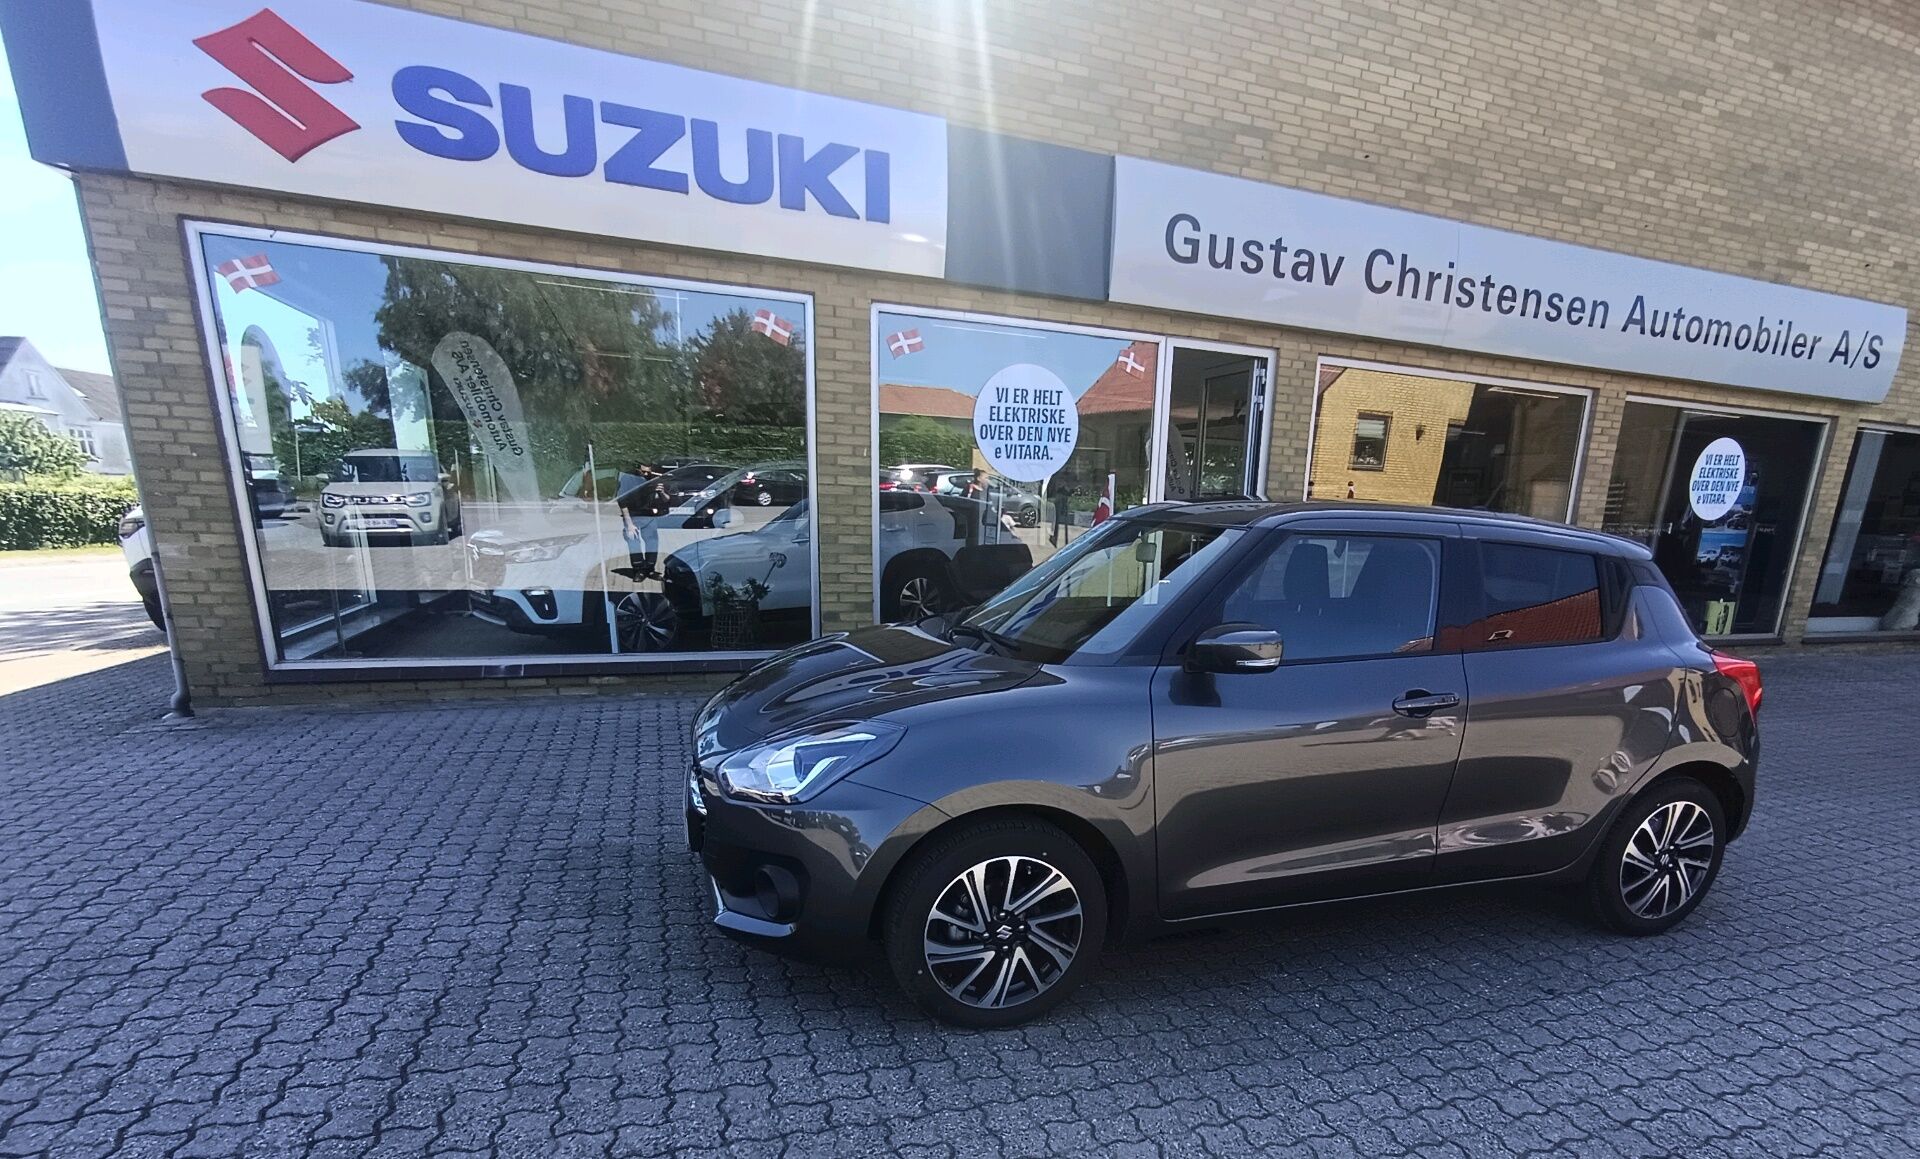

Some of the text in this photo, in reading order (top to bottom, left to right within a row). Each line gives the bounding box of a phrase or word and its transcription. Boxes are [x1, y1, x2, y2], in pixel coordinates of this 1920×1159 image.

[391, 64, 890, 224] SUZUKI
[1165, 213, 1884, 369] Gustav Christensen Automobiler A/S
[996, 387, 1063, 406] VI ER HELT
[989, 405, 1065, 424] ELEKTRISKE
[980, 424, 1072, 443] OVER DEN NYE
[995, 444, 1053, 460] e VITARA.
[1705, 454, 1740, 466] VI ER HELT
[1699, 467, 1739, 479] ELEKTRISKE
[1692, 480, 1740, 492] OVER DEN NYE
[1696, 495, 1701, 504] e
